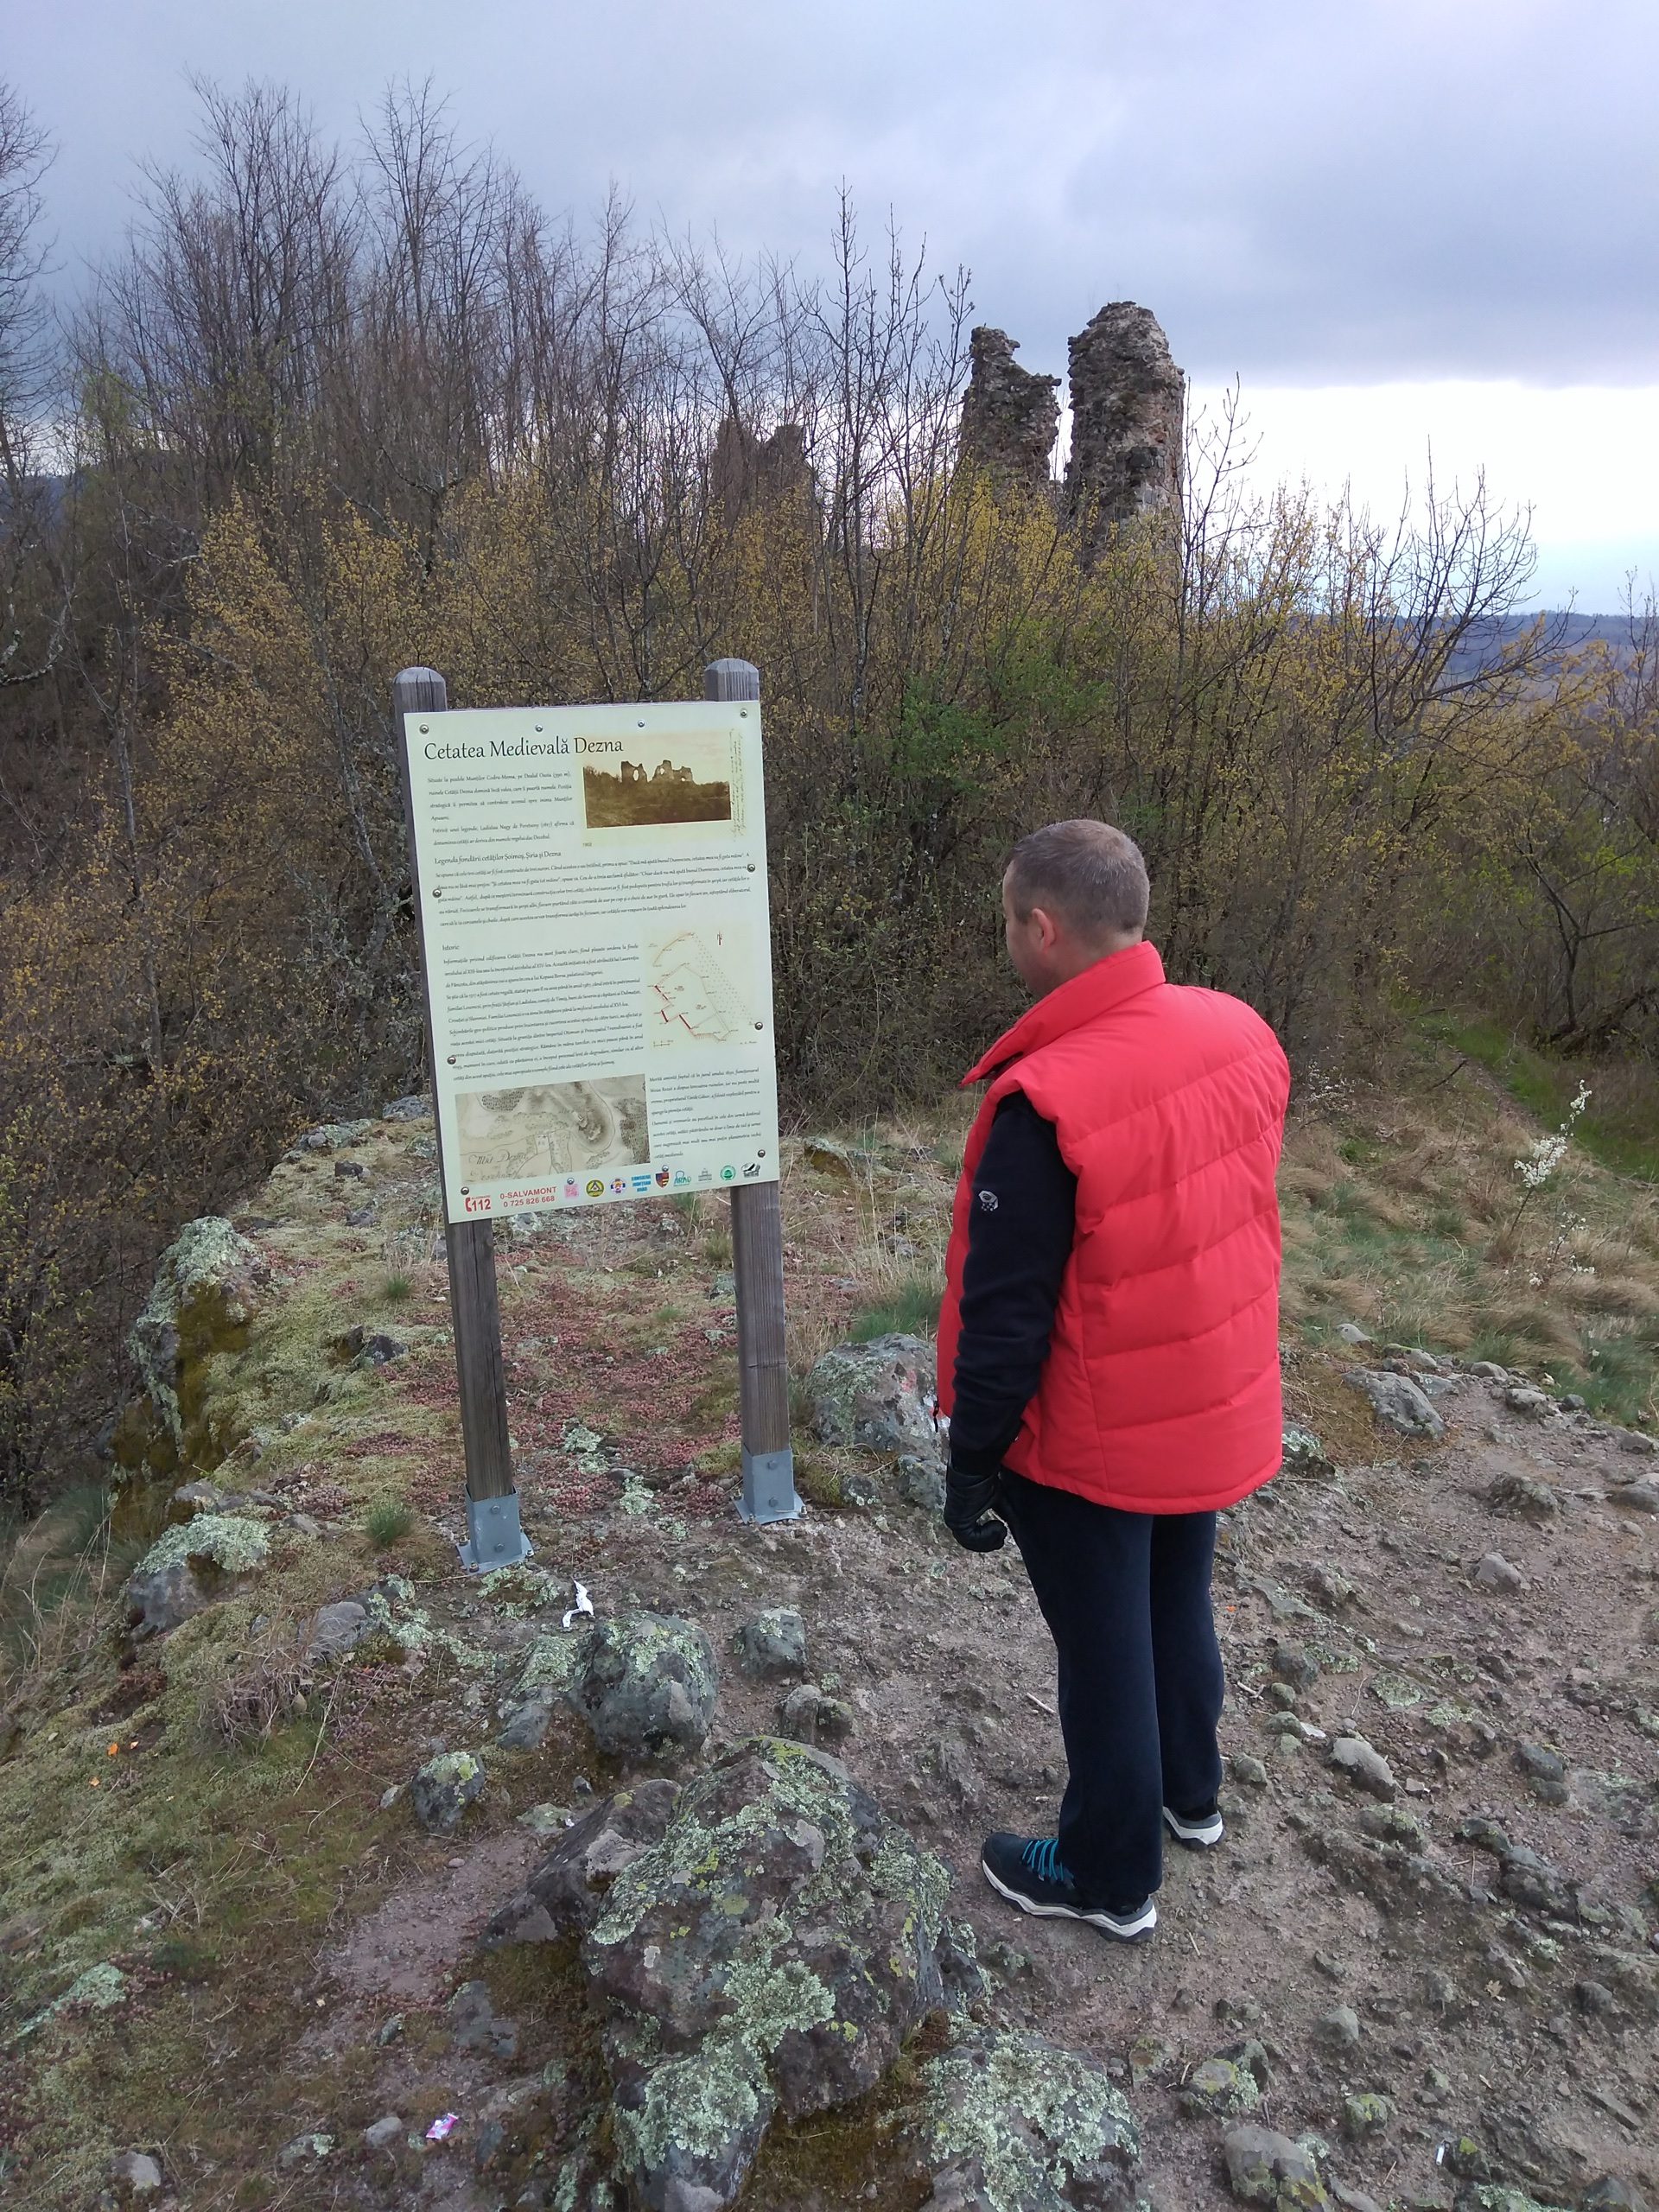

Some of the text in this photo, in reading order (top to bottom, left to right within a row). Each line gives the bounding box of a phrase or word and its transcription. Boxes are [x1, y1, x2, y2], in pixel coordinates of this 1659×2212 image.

[424, 735, 623, 759] Cetatea Medievală Dezna
[434, 855, 458, 866] Legenda
[458, 854, 481, 864] fondării
[481, 853, 503, 862] cetăților
[499, 1186, 556, 1199] 0-SALVAMONT
[471, 1198, 491, 1211] 112
